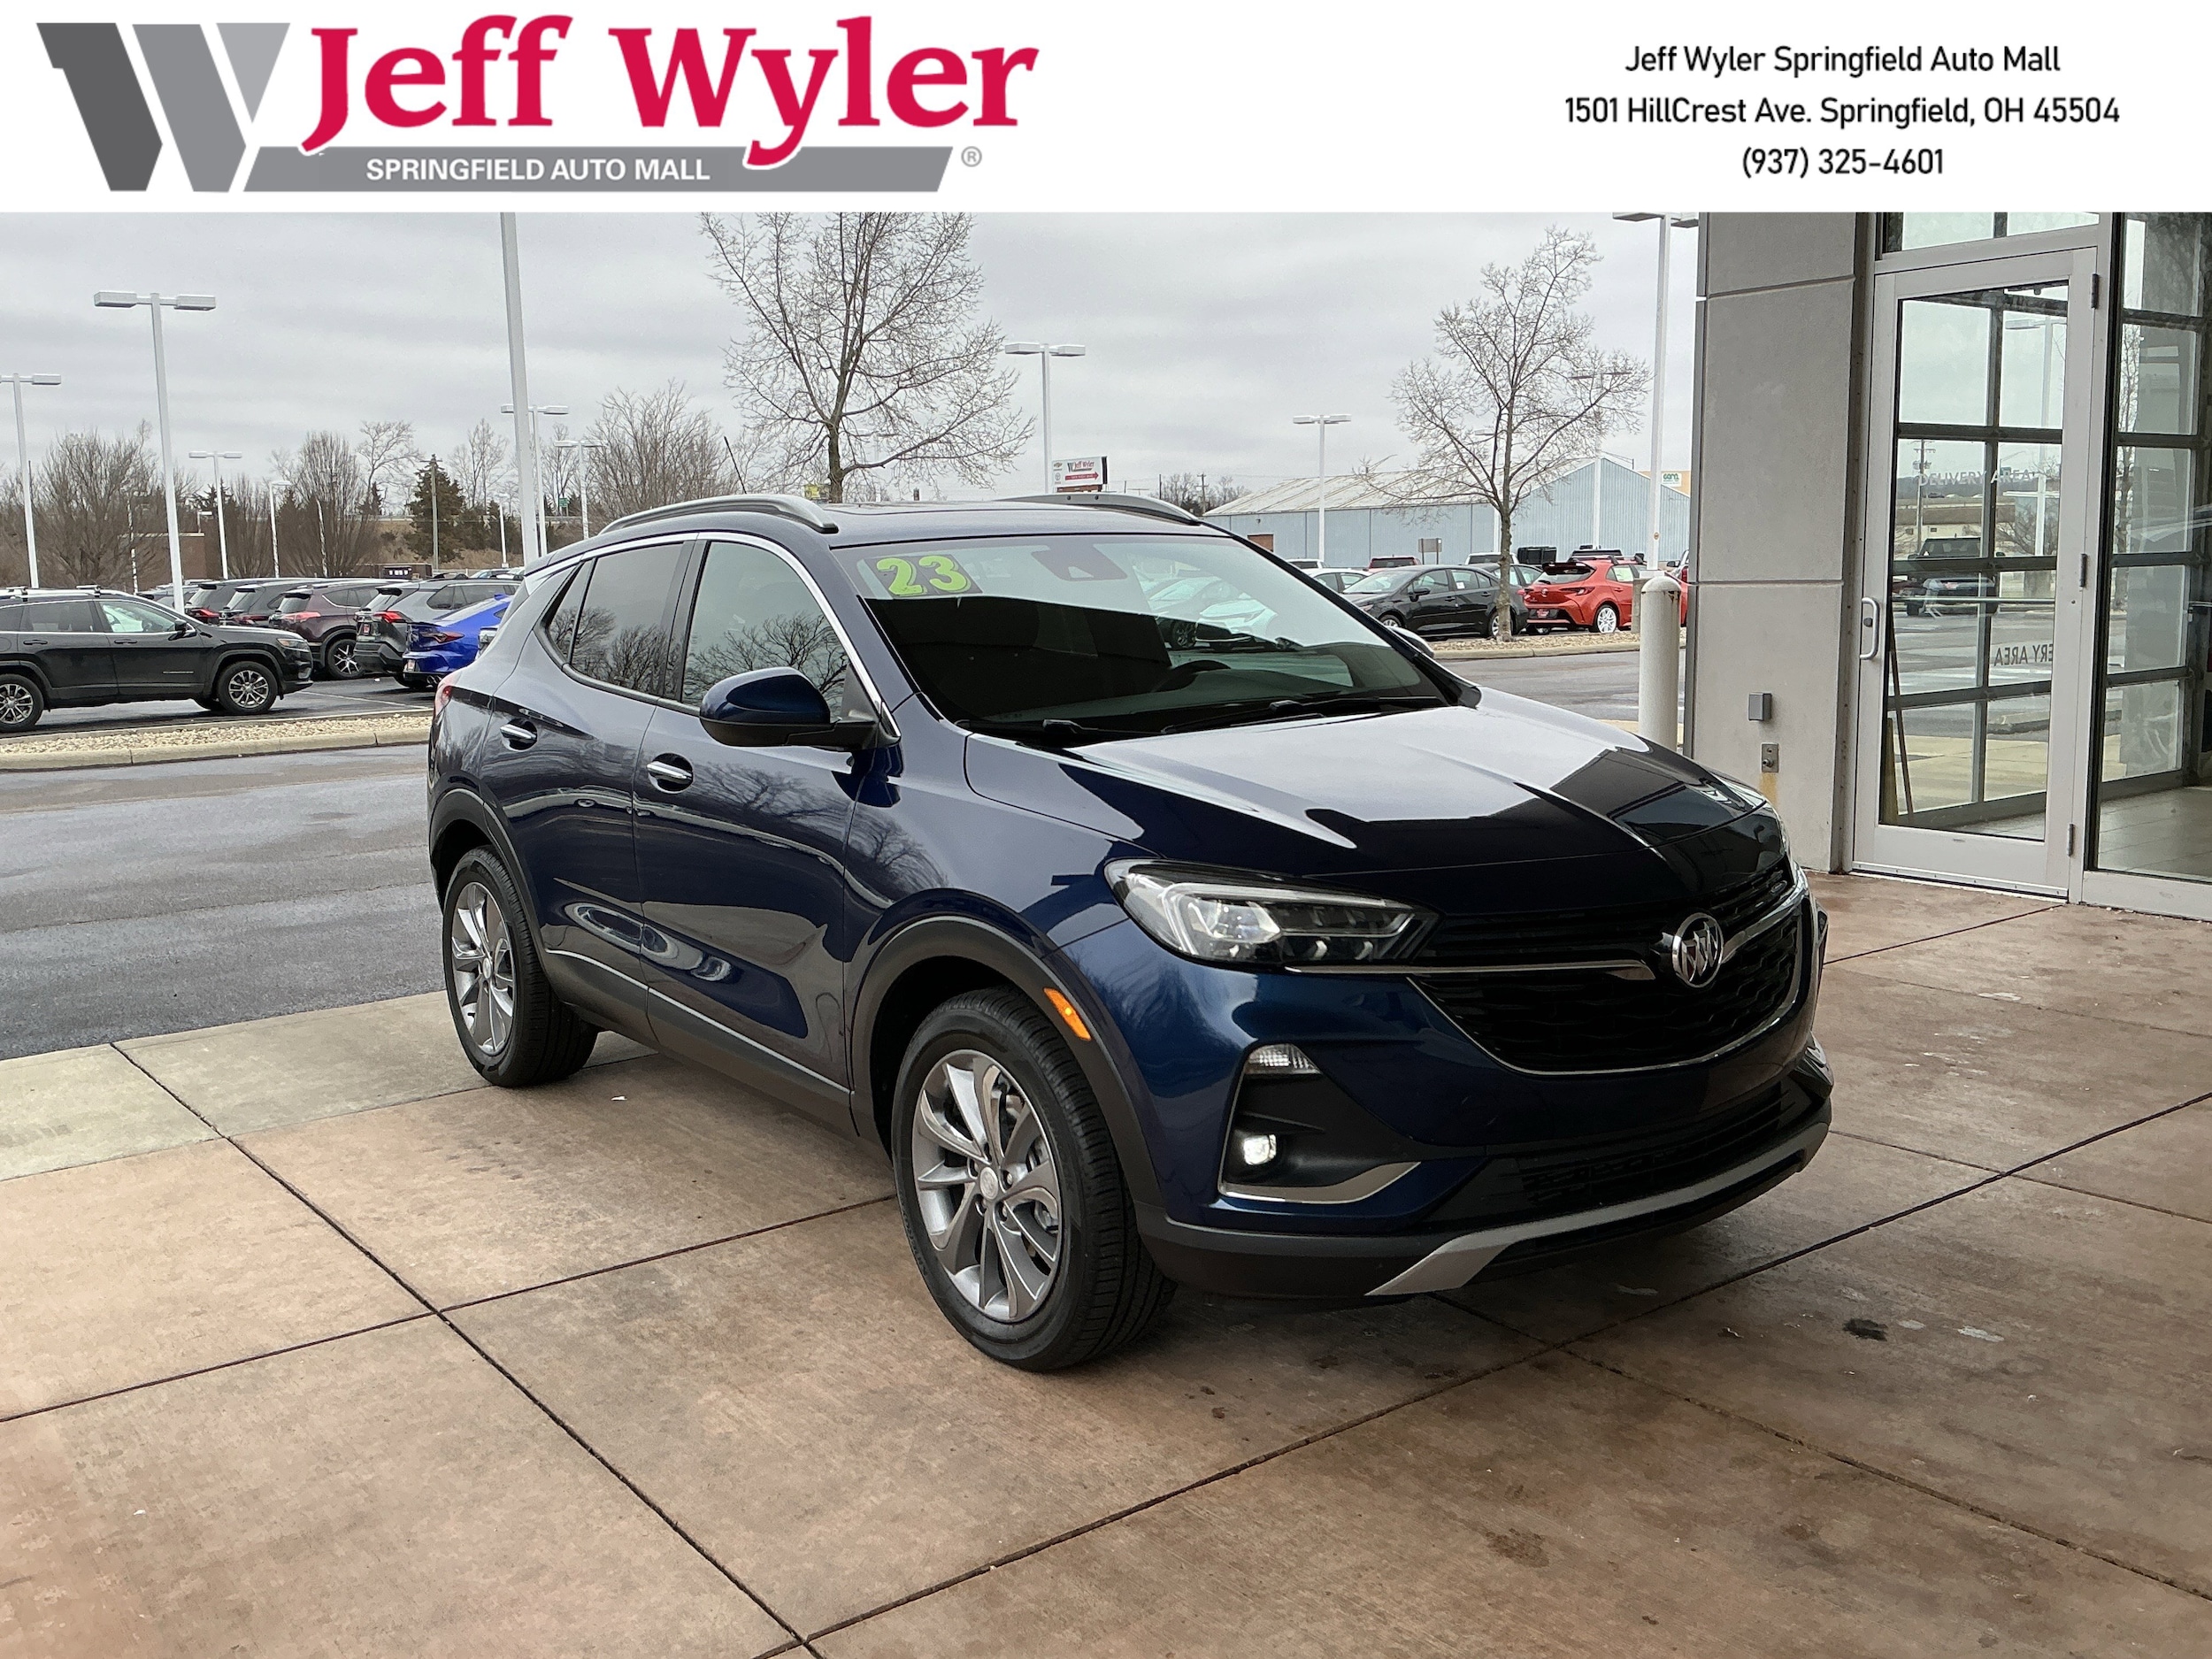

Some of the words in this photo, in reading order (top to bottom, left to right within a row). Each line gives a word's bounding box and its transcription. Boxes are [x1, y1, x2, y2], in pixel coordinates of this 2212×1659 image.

[1918, 471, 1986, 487] DELIVERY
[1990, 469, 2031, 484] AREA
[876, 555, 971, 596] 23
